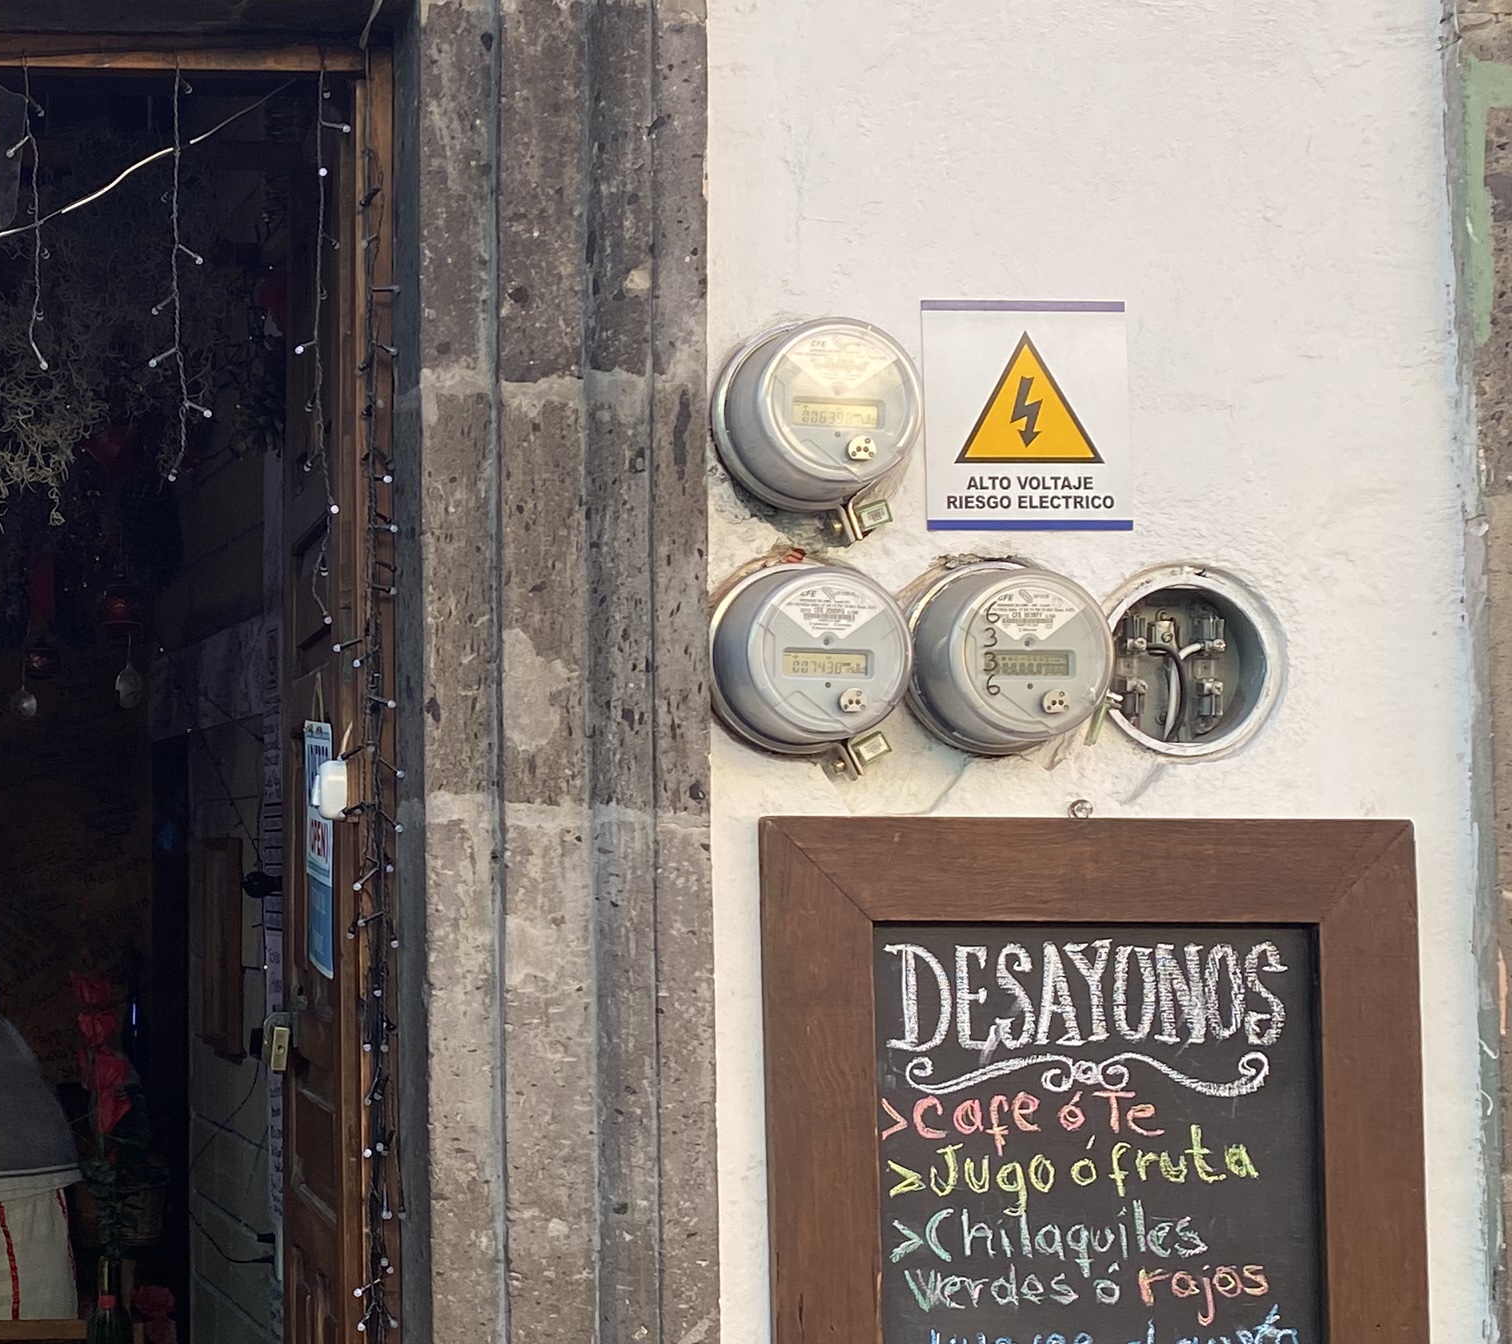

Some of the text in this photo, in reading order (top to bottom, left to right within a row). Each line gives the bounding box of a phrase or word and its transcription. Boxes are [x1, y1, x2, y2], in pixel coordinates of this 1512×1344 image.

[946, 495, 1115, 510] RIESGO ELECTRICO
[966, 476, 1094, 491] ALTO VOLTAJE
[882, 938, 1289, 1052] DESAYUNOS
[1091, 1090, 1166, 1138] Te
[929, 1143, 1056, 1217] Jugo
[1108, 1123, 1261, 1198] fruta
[924, 1199, 1210, 1279] Chilaquiles
